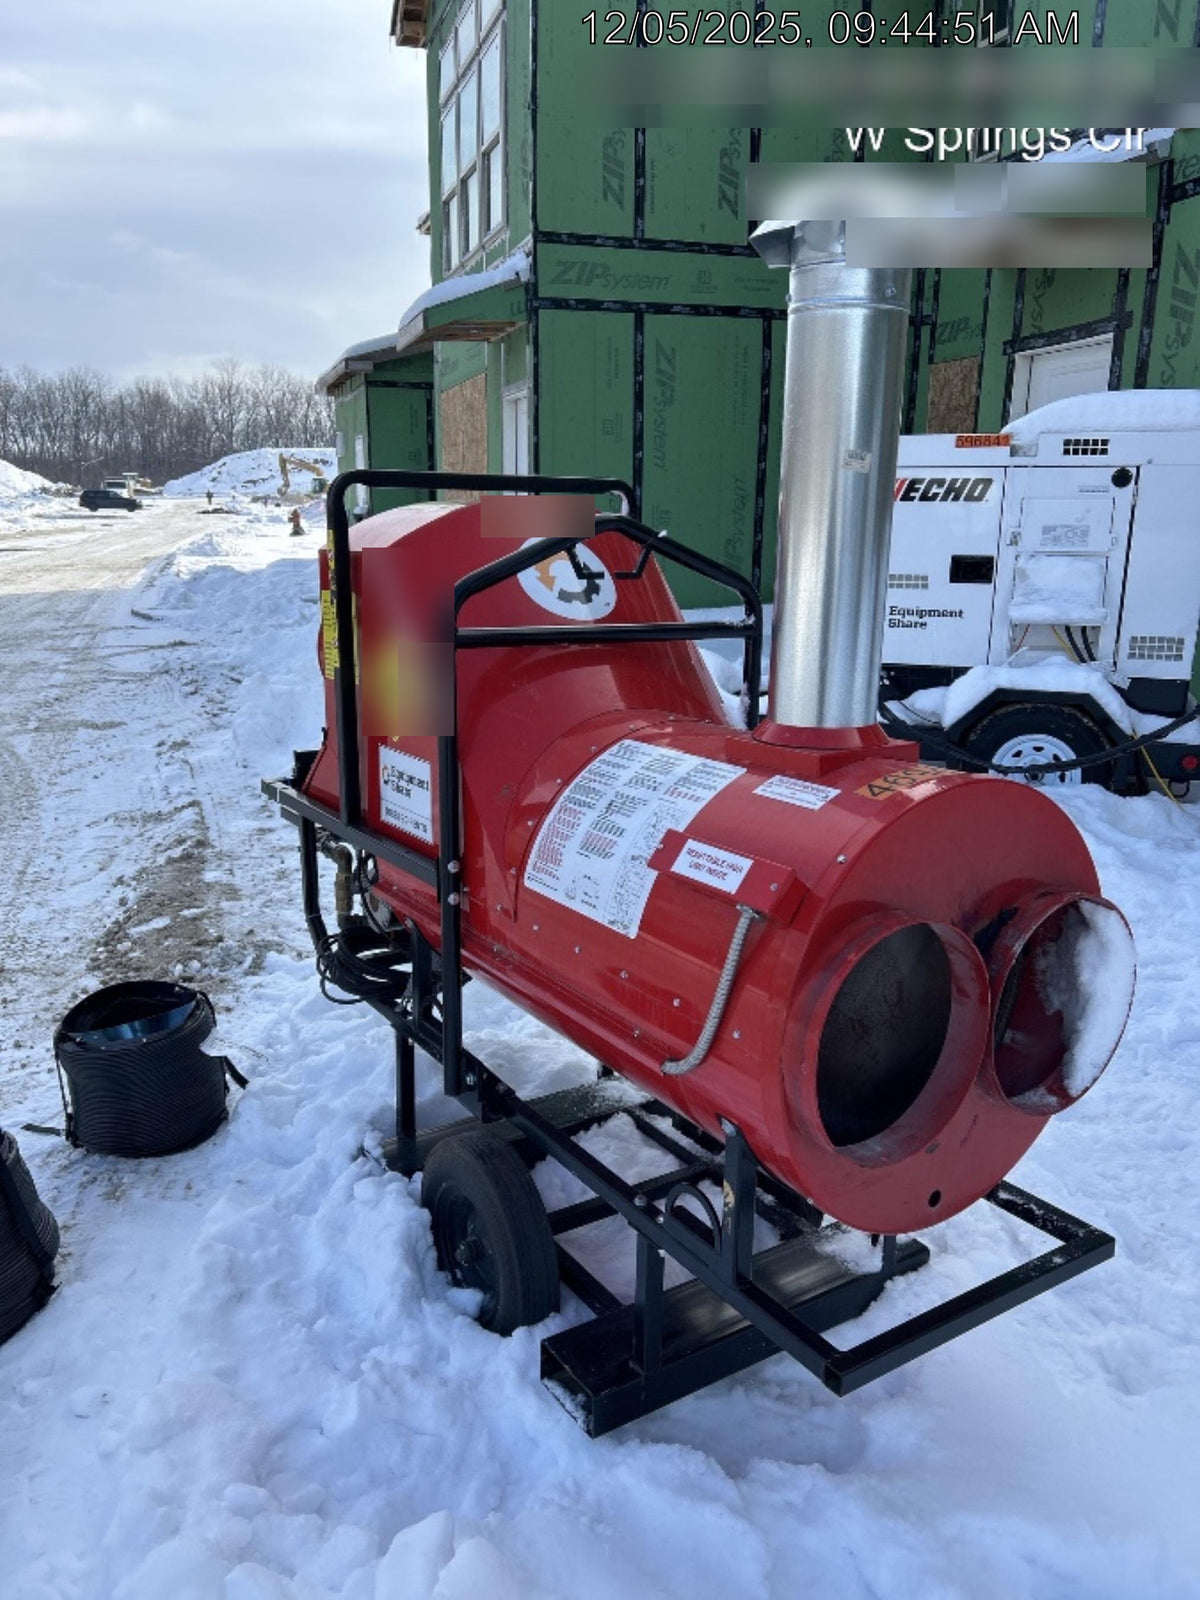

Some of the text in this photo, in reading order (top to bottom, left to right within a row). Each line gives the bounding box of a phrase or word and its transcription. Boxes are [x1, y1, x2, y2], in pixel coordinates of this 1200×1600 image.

[900, 478, 993, 502] ECHO
[889, 606, 964, 619] Equipment
[888, 618, 928, 630] Share
